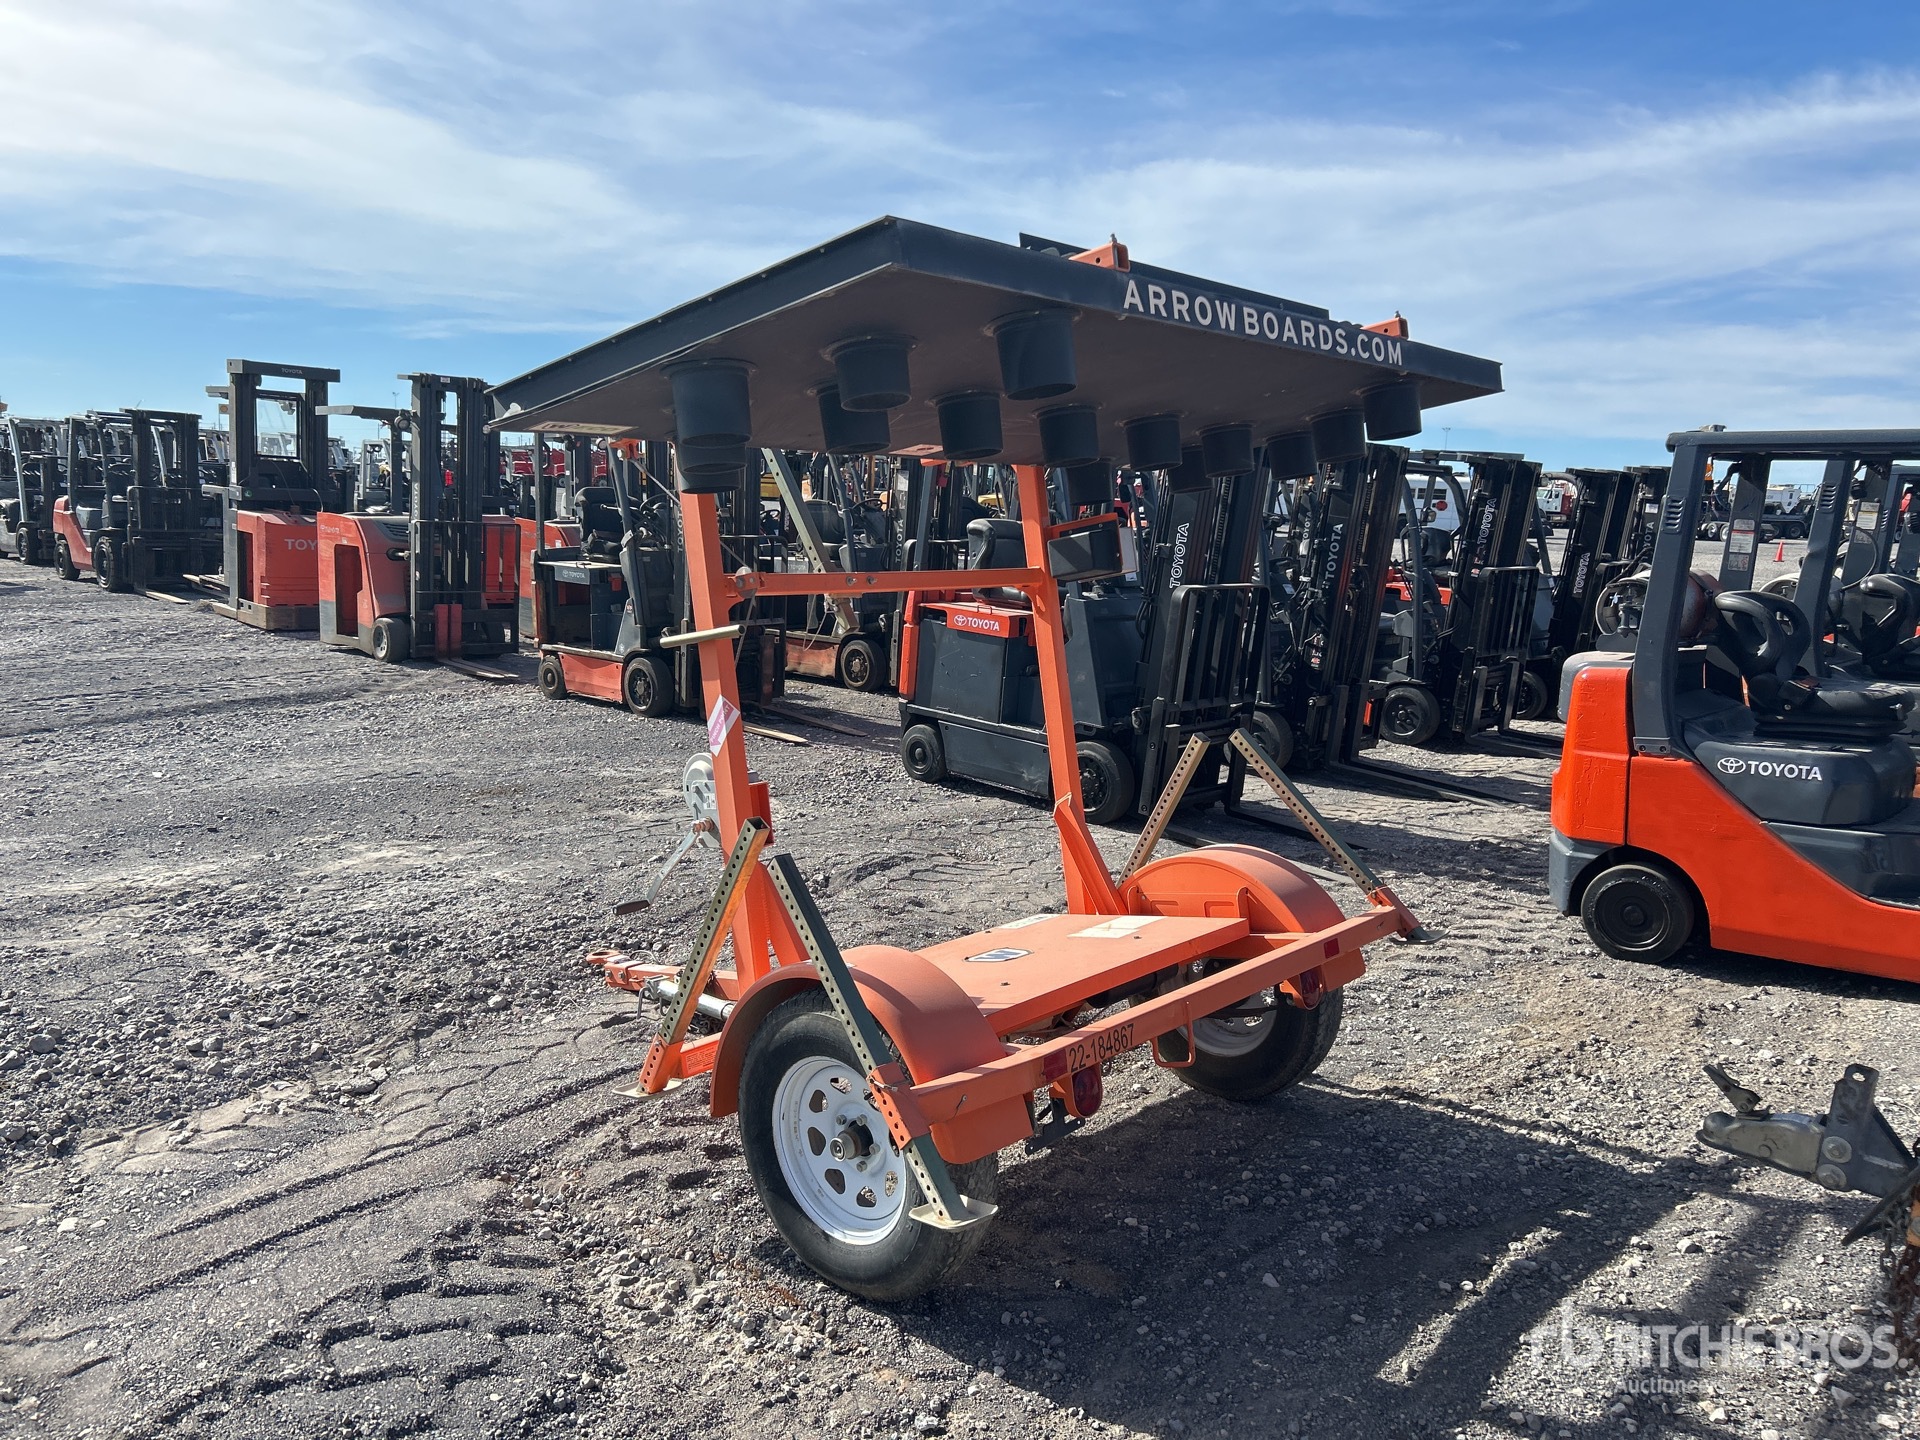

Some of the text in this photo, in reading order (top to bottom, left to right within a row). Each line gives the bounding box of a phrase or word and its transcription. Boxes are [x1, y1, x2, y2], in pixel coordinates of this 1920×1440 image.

[1123, 279, 1403, 366] ARROWBOARDS.COM
[281, 367, 303, 375] TOYOTA
[895, 519, 904, 562] TOYOTA
[1301, 511, 1312, 542] OYOTA
[1477, 498, 1497, 544] TOYOTA
[284, 538, 318, 551] TOY
[1169, 523, 1189, 588] TOYOTA
[1324, 523, 1343, 581] TOYOTA
[568, 570, 585, 578] TOYOTA
[1573, 552, 1590, 594] TOYOTA
[967, 617, 1000, 632] TOYOTA
[1748, 760, 1822, 781] TOYOTA
[1069, 1023, 1134, 1073] 22-184867
